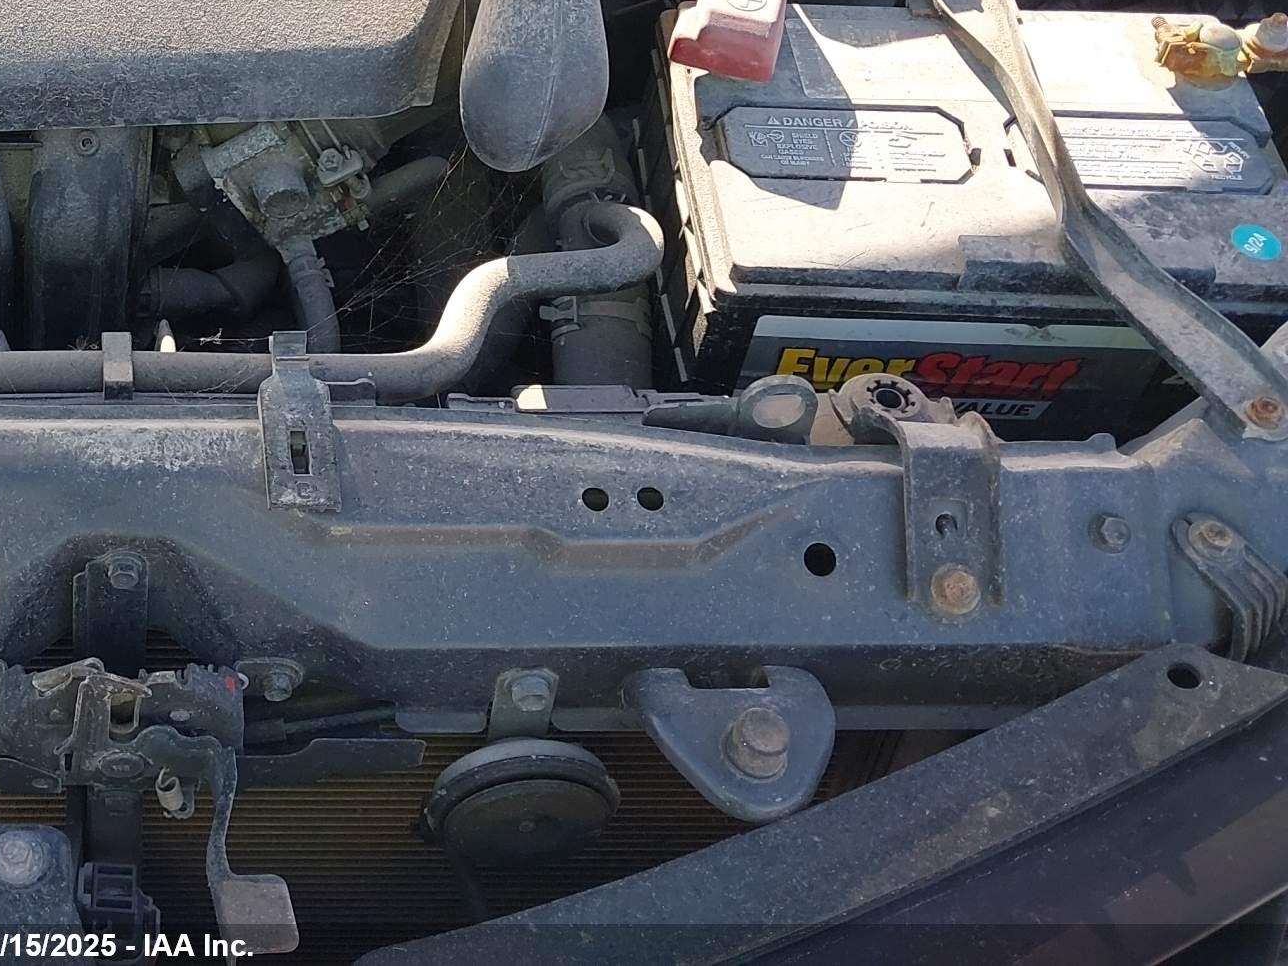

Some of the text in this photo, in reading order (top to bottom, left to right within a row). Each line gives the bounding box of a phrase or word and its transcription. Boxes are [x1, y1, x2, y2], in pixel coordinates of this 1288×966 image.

[782, 117, 843, 127] DANGER
[1243, 232, 1268, 254] 9/24
[775, 346, 1083, 397] EverStart
[953, 401, 1036, 417] VALUE
